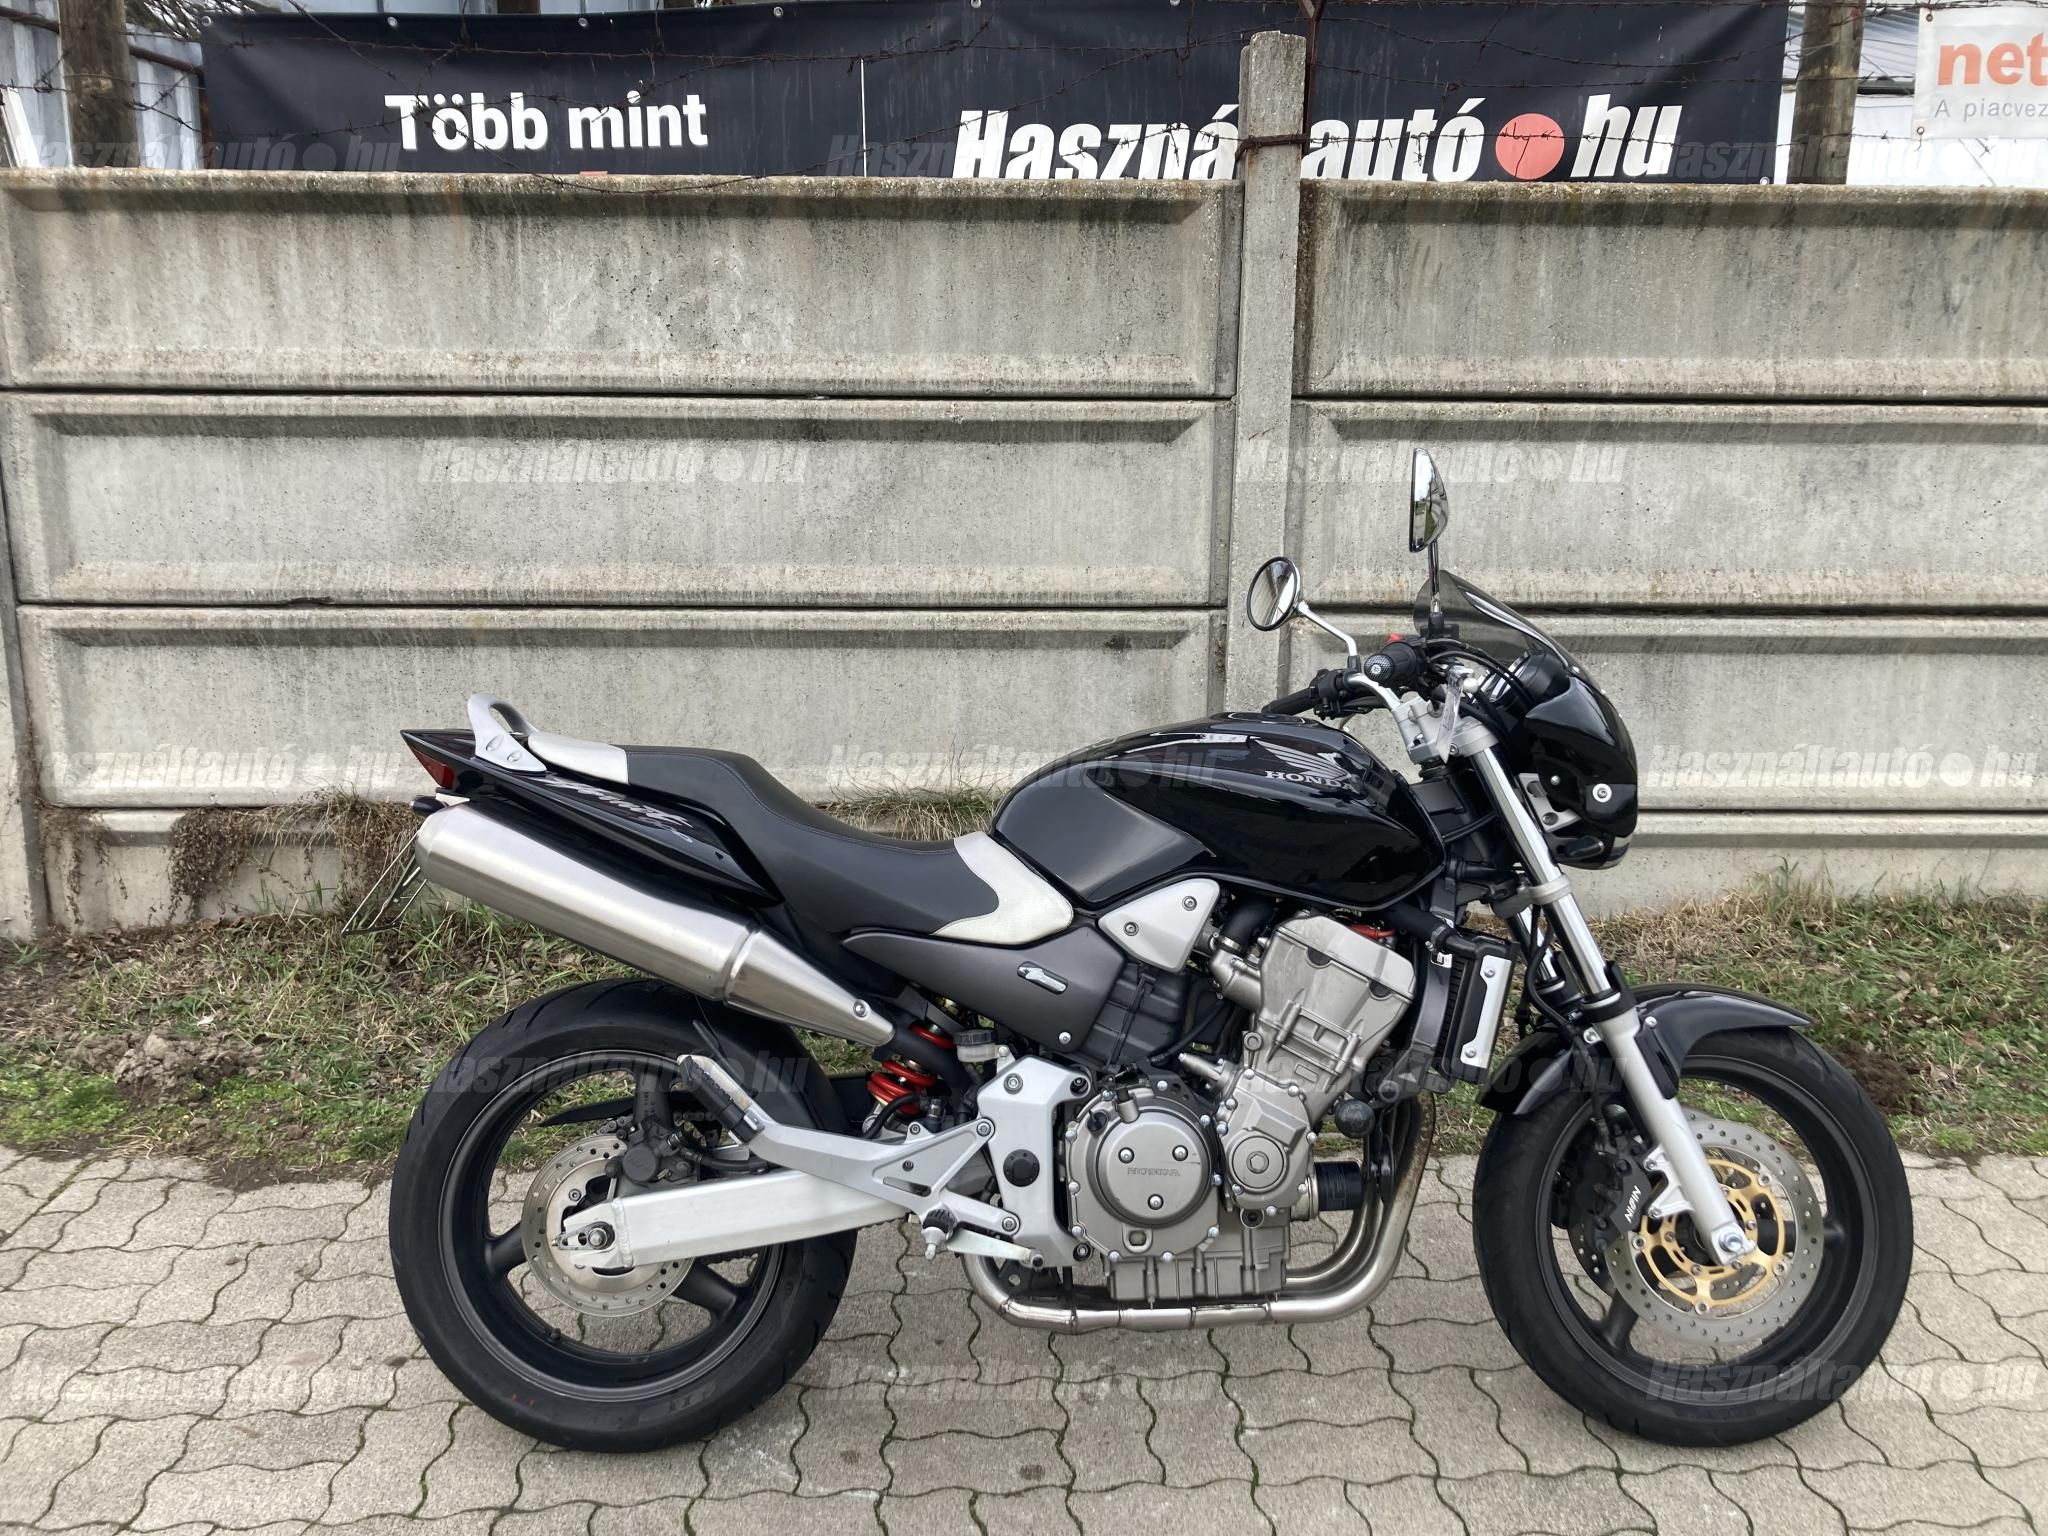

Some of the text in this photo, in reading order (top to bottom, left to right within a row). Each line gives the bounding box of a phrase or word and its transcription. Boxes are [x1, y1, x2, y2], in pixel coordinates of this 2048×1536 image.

[384, 89, 709, 151] Több mint
[1934, 98, 1951, 118] A
[1264, 770, 1360, 795] HONDA
